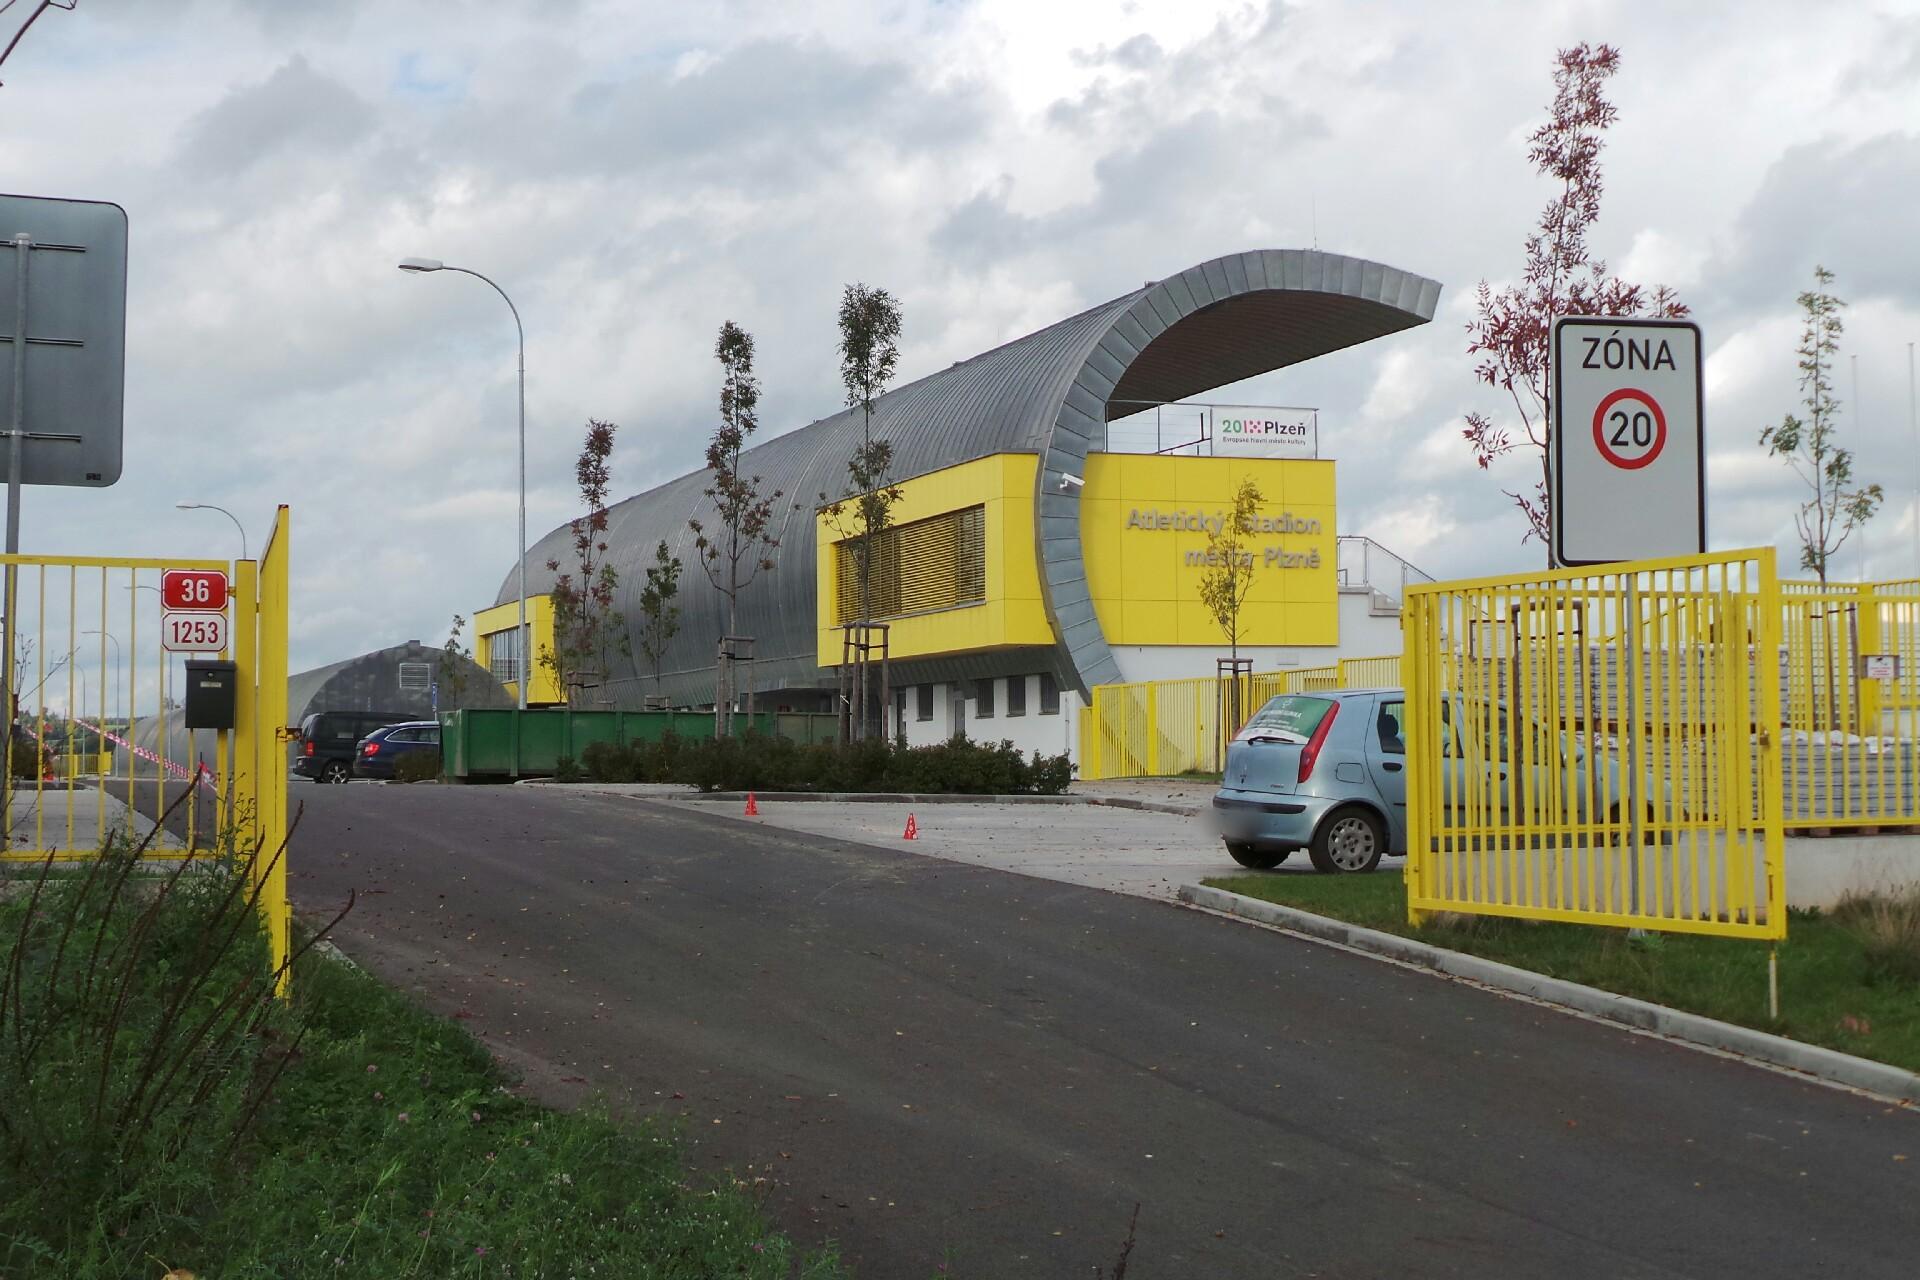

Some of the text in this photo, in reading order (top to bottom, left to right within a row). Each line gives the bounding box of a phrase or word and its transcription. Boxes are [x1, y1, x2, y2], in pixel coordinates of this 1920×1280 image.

[1582, 329, 1676, 371] ZÓNA
[1264, 420, 1306, 436] Plzeň
[1609, 410, 1651, 447] 20
[1126, 508, 1225, 538] Atletický
[1263, 546, 1321, 570] Plzně
[181, 578, 209, 602] 36
[171, 620, 219, 644] 1253
